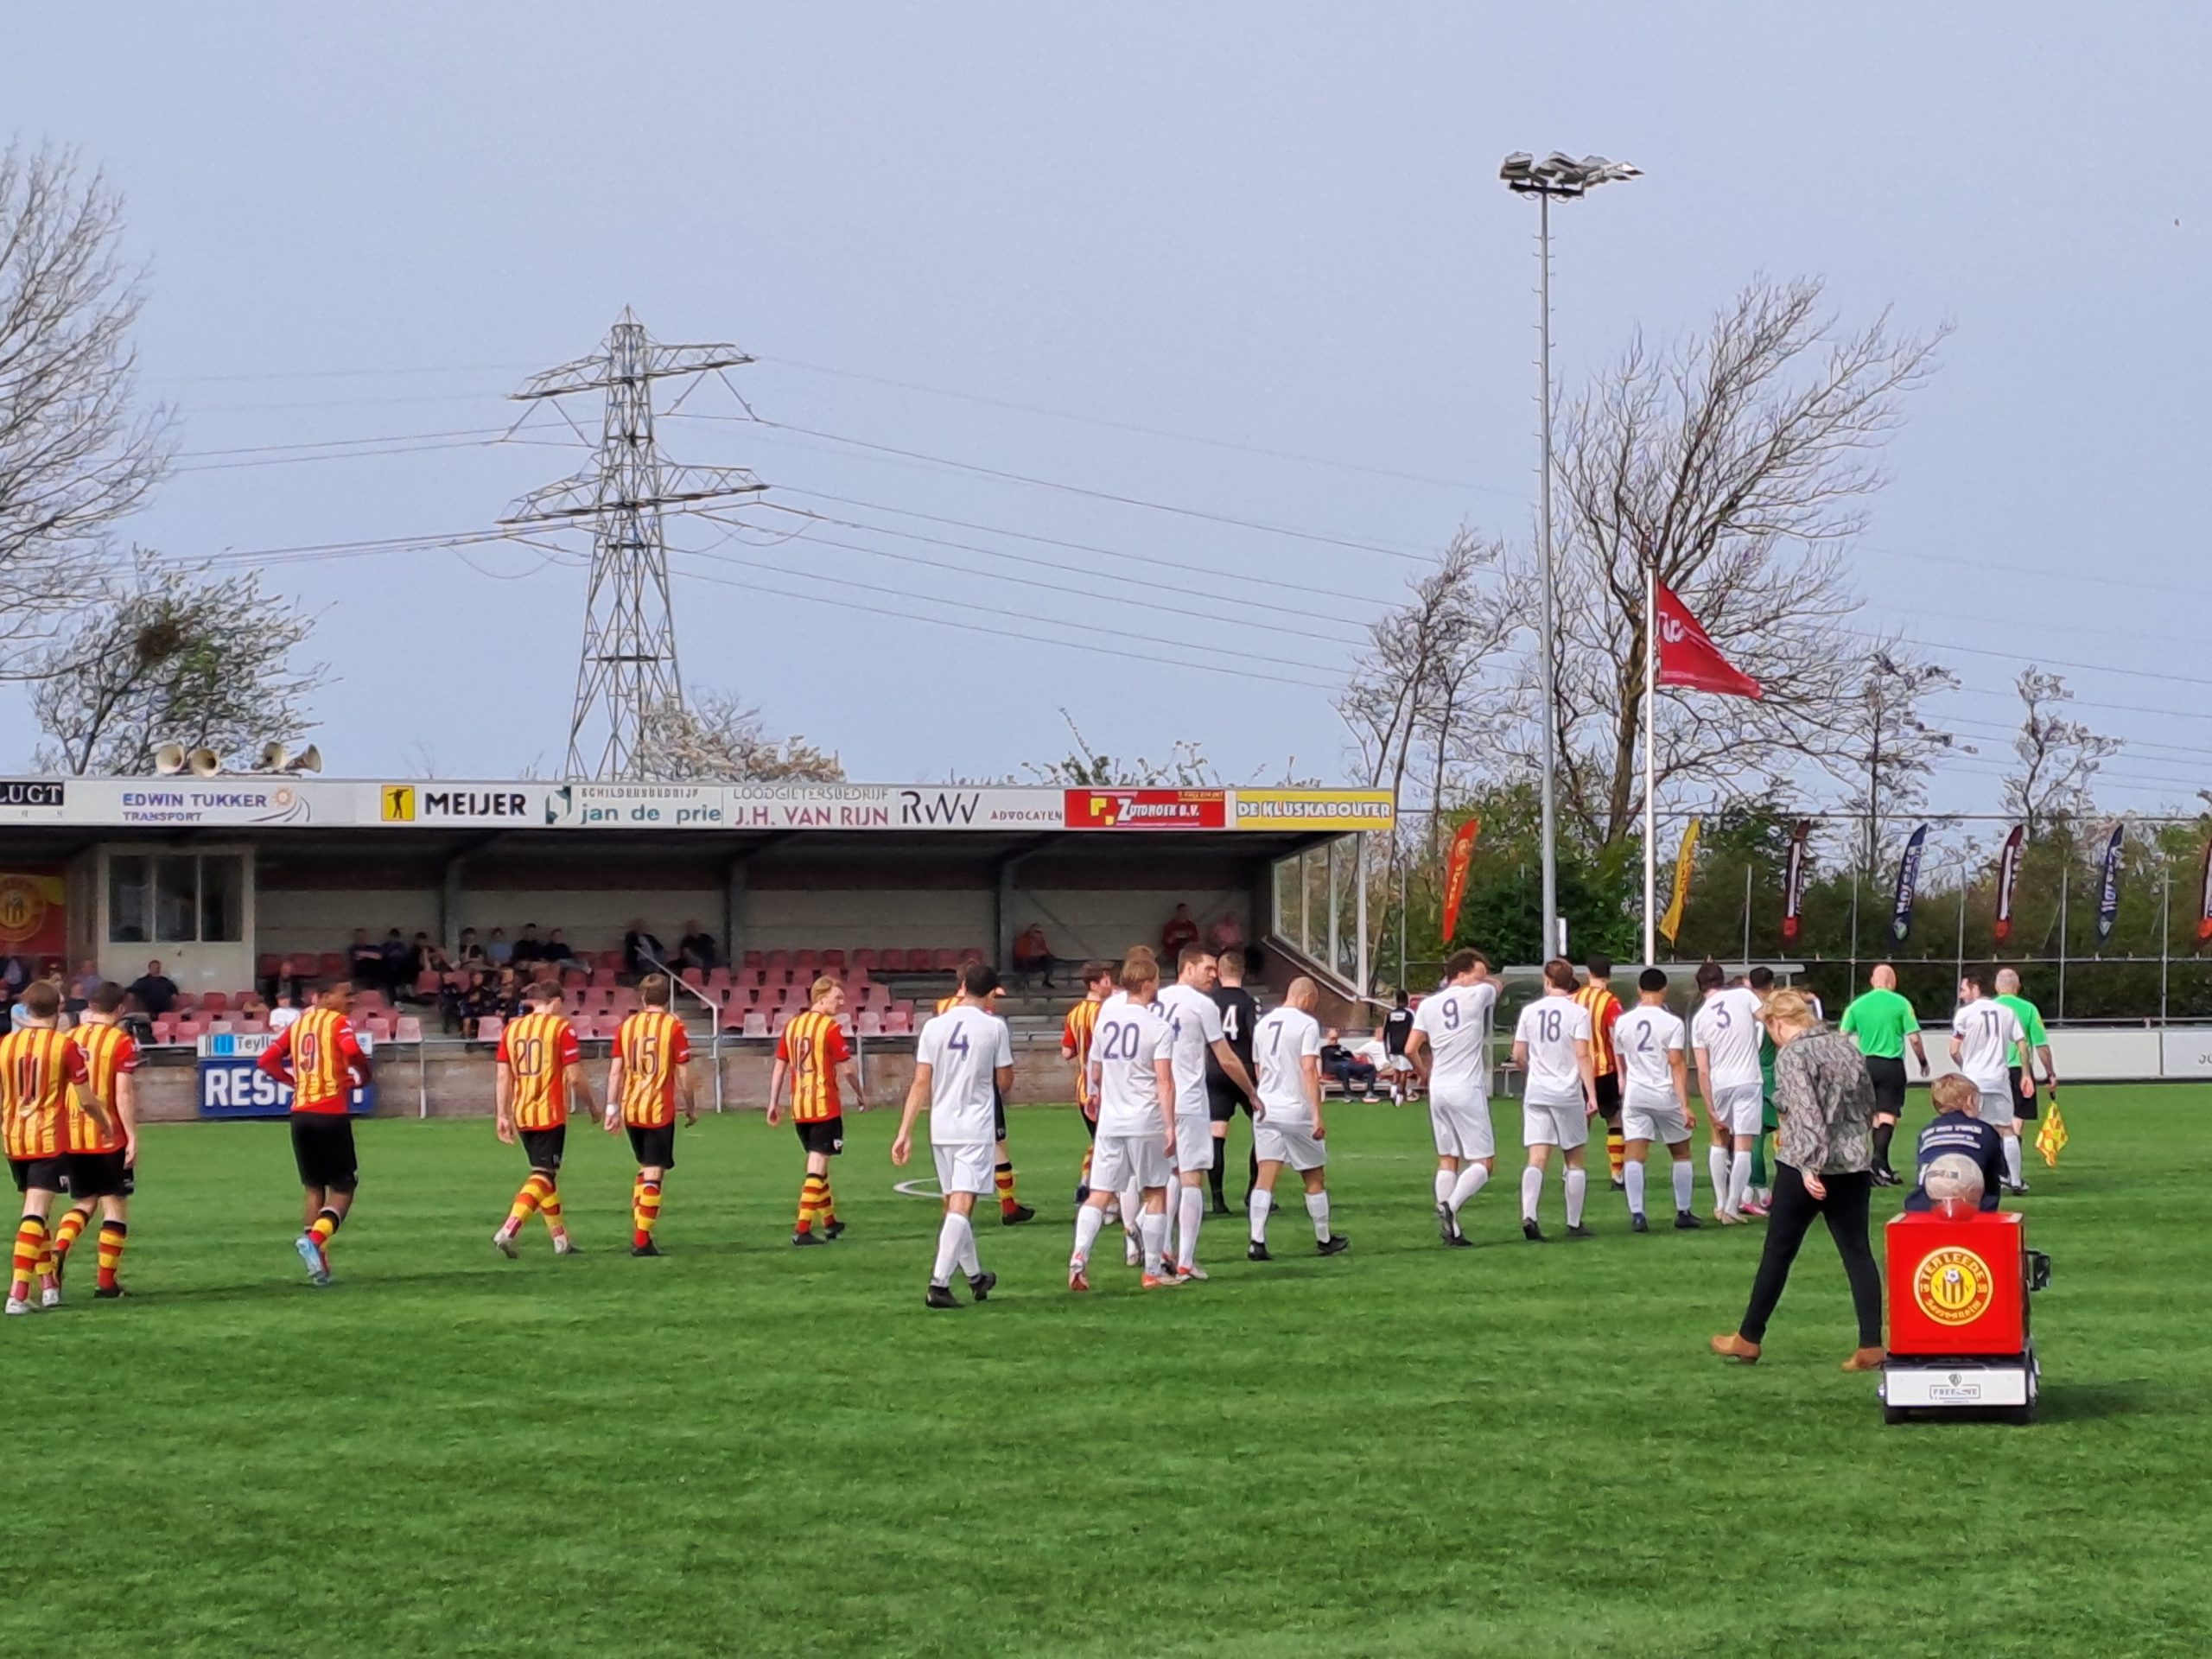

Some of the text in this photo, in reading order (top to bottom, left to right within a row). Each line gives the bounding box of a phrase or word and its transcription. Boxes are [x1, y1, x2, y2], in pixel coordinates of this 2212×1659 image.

[123, 792, 267, 807] EDWIN TUKKER
[425, 793, 526, 816] MEIJER
[581, 804, 721, 824] jan de prie
[735, 806, 888, 825] J.H. VAN RIJN
[990, 810, 1063, 821] ADVOCATEN
[1237, 801, 1391, 818] DE KLUSKABOUTER
[123, 811, 202, 821] TRANSPORT
[1223, 1004, 1239, 1040] 4
[1442, 998, 1459, 1030] 9
[1537, 1009, 1561, 1043] 18
[1711, 1001, 1731, 1028] 3
[1980, 1010, 1999, 1038] 11
[947, 1020, 969, 1062] 4
[1103, 1020, 1140, 1060] 20
[1268, 1020, 1284, 1056] 7
[1637, 1020, 1654, 1052] 2
[299, 1033, 316, 1072] 9
[513, 1038, 543, 1077] 20
[632, 1037, 658, 1076] 15
[795, 1036, 814, 1073] 12
